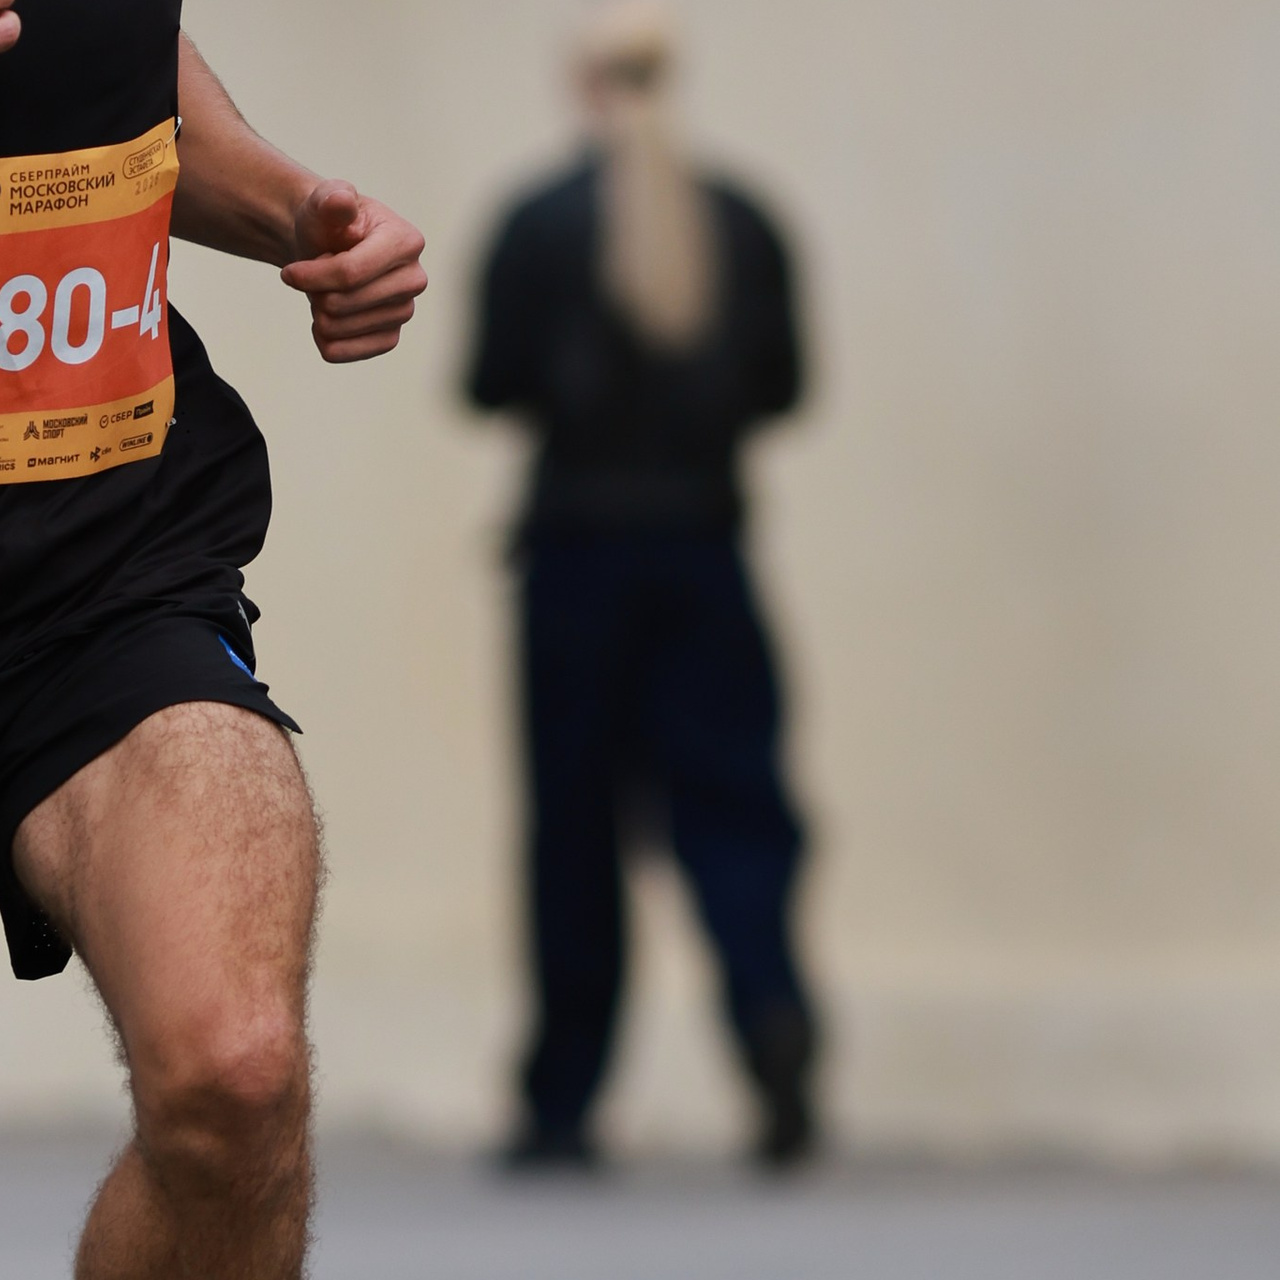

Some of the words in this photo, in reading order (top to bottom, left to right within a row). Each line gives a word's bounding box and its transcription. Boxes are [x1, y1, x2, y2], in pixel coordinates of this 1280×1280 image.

[10, 164, 90, 183] СБЕРПРАЙМ
[10, 172, 115, 200] МОСКОВСКИЙ
[10, 194, 89, 216] МАРАФОН
[42, 413, 88, 429] МОСКОВСКИЙ
[111, 410, 132, 424] СБЕР
[42, 428, 65, 440] СПОРТ
